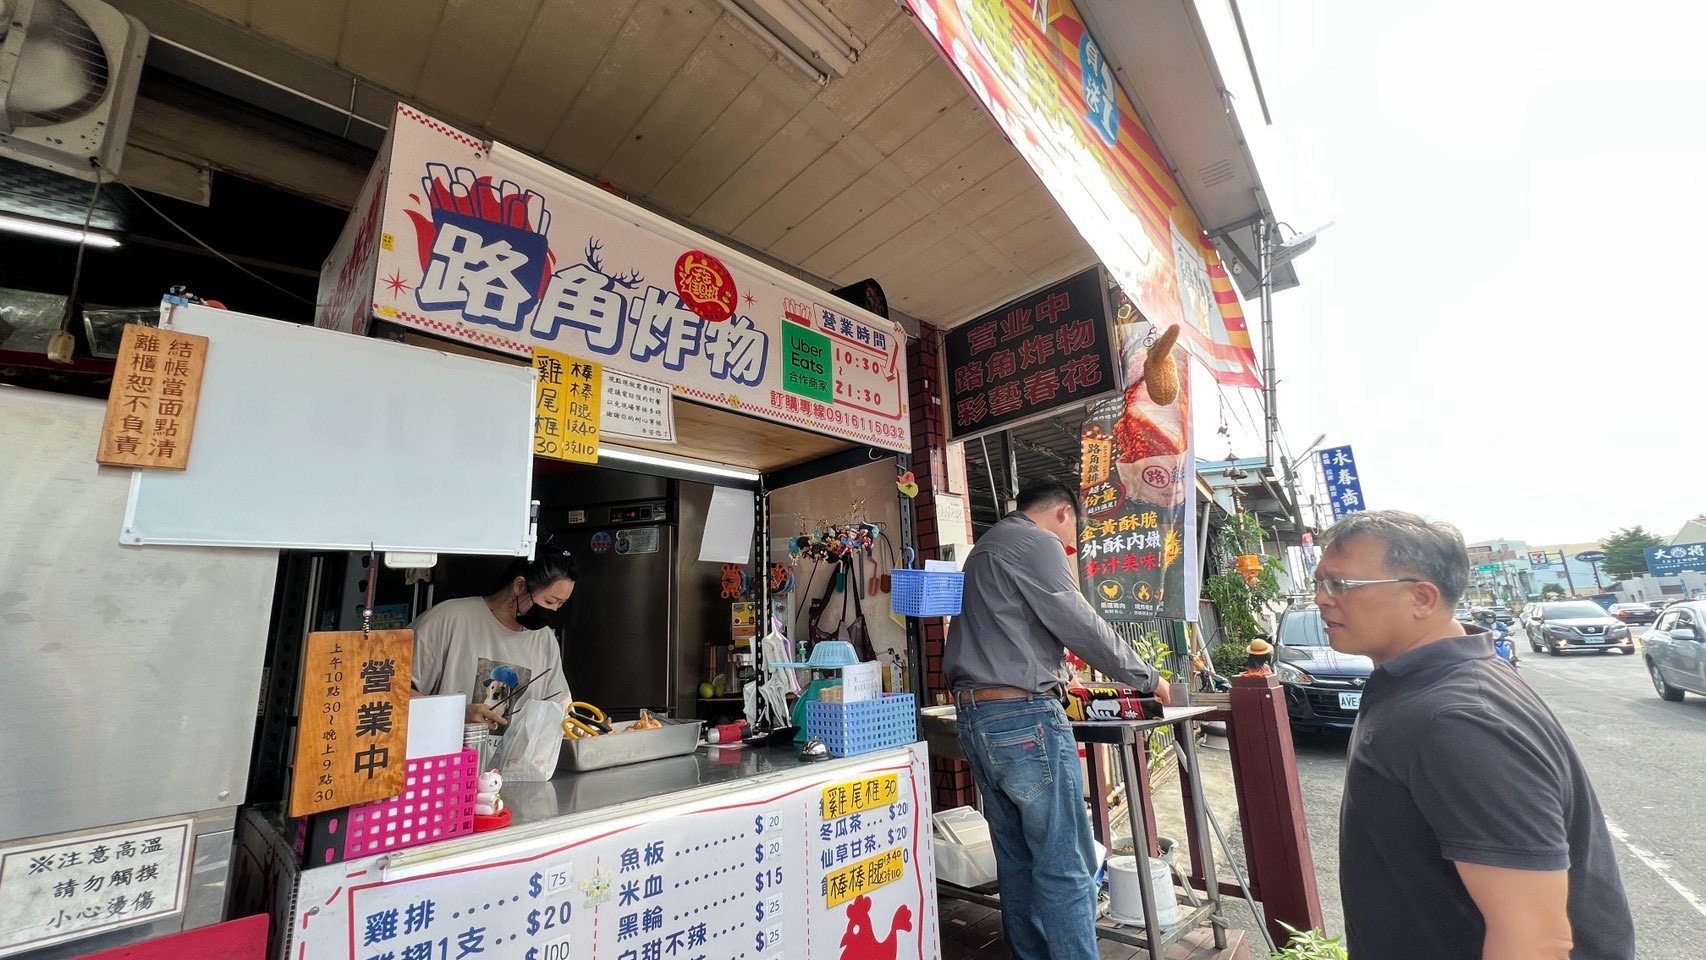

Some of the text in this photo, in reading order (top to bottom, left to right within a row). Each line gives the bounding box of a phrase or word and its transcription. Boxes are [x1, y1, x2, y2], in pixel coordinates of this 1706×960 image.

[415, 222, 769, 387] 路角炸物
[791, 335, 823, 358] Uber
[822, 310, 886, 350] 營業時間
[791, 352, 823, 375] Eats
[836, 347, 879, 374] 10:30
[955, 319, 1095, 394] 路角炸物
[114, 333, 161, 456] 離櫃恕不負責
[148, 339, 194, 459] 結帳當面點清
[789, 370, 828, 392] 合作商家
[836, 380, 881, 405] 21:30
[957, 354, 1102, 426] 彩藝春花
[1082, 487, 1117, 508] 份量
[1332, 449, 1359, 513] 永春齒
[1079, 511, 1158, 543] 金黃酥脆
[1079, 531, 1161, 560] 外酥內嫩
[354, 658, 395, 780] 營業中
[620, 814, 779, 874] 魚板 $20
[820, 813, 861, 841] 冬瓜茶
[820, 834, 876, 869] 仙草甘茶
[53, 863, 159, 899] 請勿觸摸
[619, 842, 780, 906] 米血 $20
[47, 891, 156, 929] 小心燙傷
[364, 872, 566, 947] 雞排 $75
[526, 901, 571, 936] $20
[617, 866, 783, 942] 黑輪 $15
[755, 900, 780, 922] $25
[755, 929, 780, 953] $25
